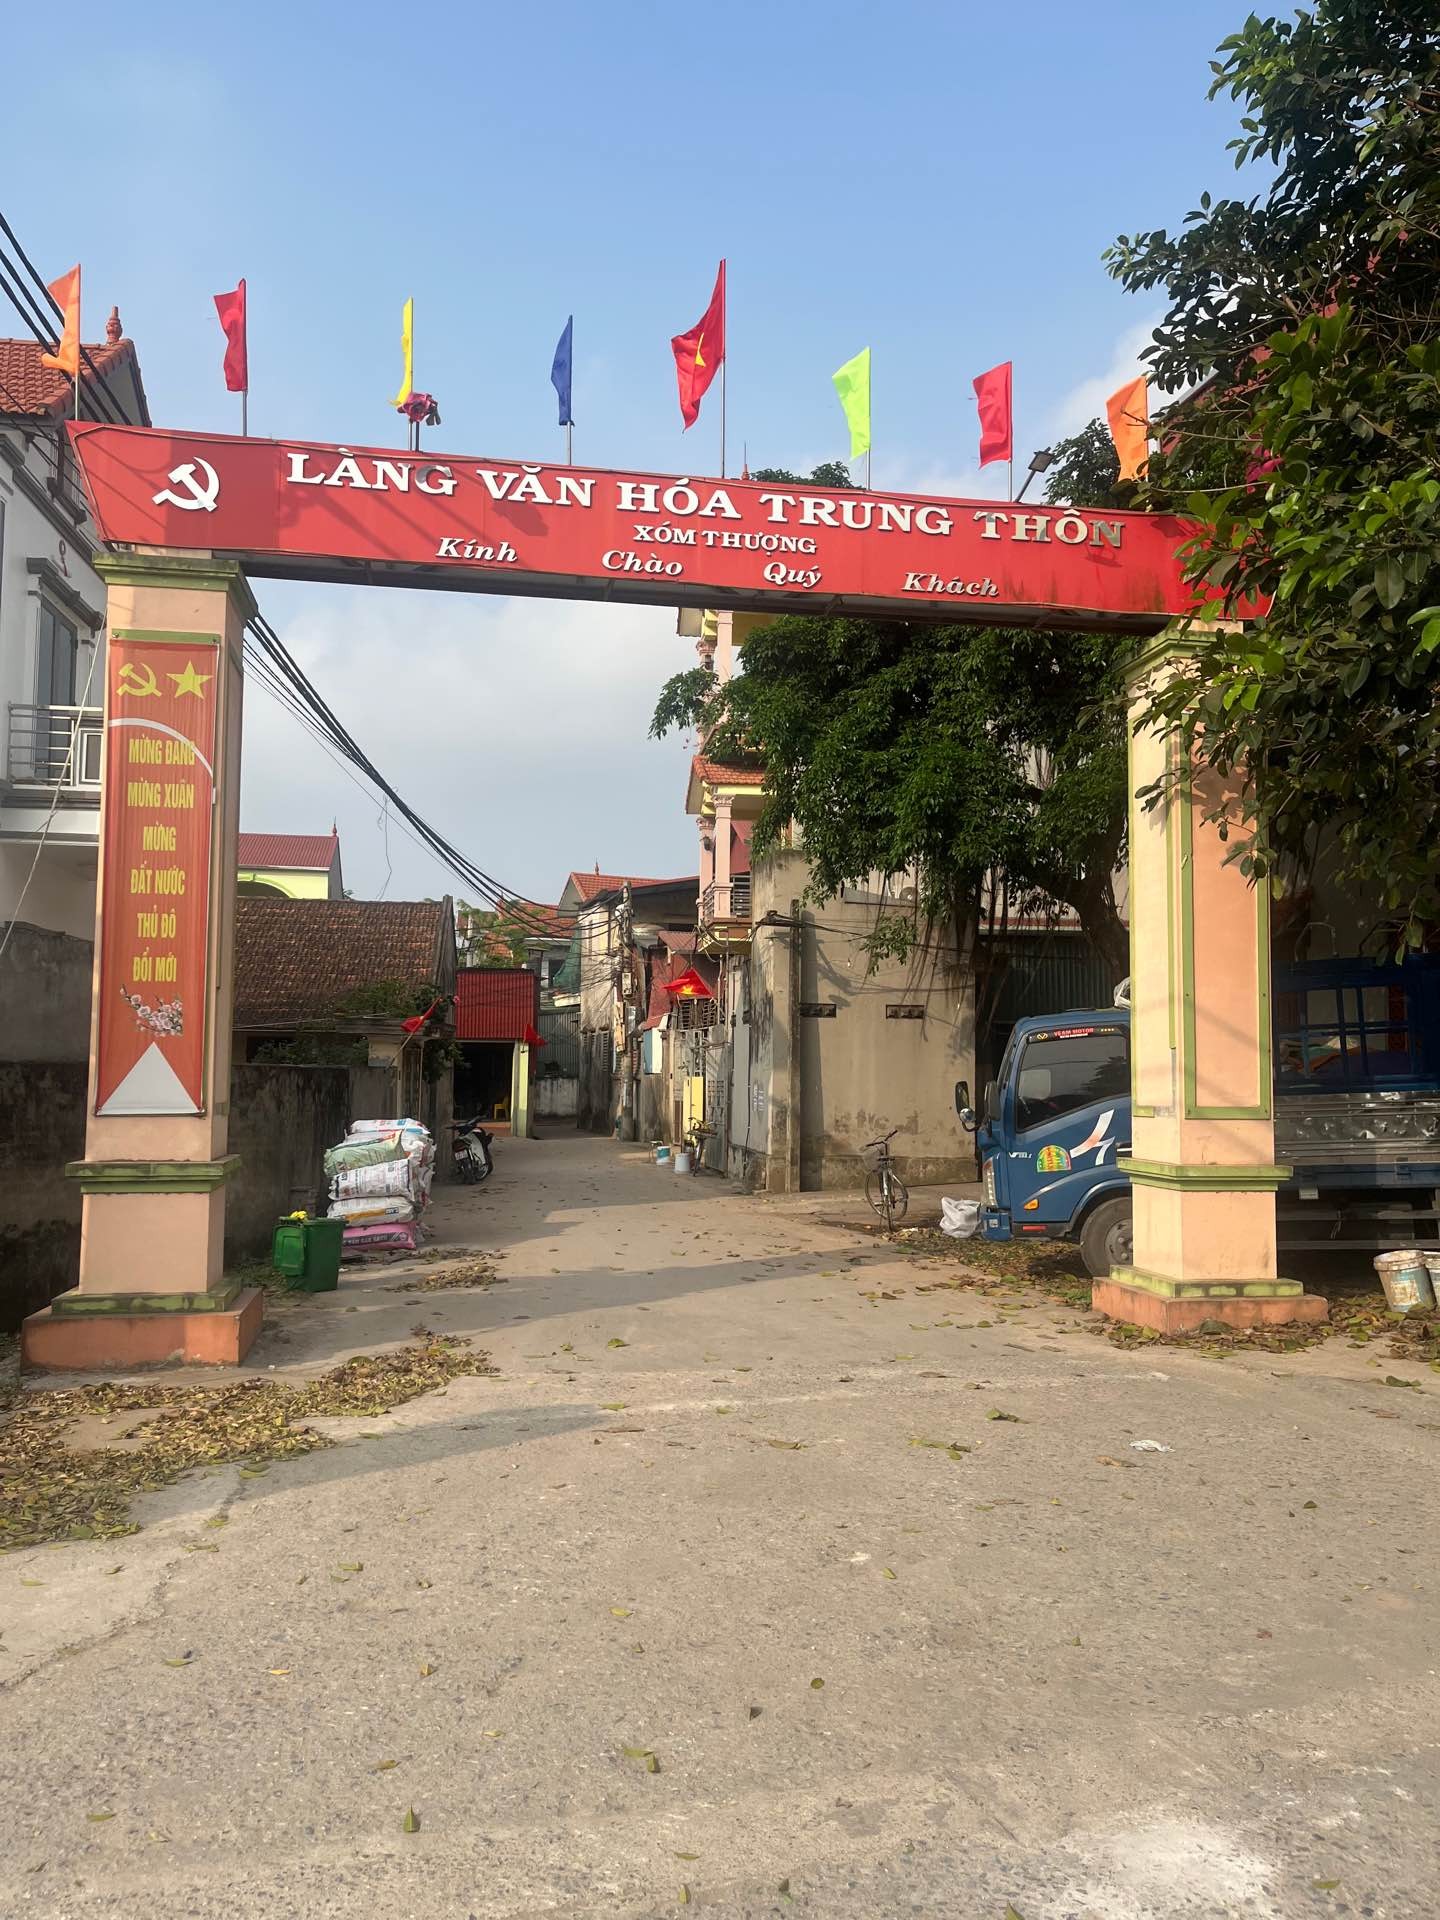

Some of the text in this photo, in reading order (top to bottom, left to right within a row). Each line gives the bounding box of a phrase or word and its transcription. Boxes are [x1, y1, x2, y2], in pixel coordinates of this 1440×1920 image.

[286, 447, 1125, 548] LÀNG VĂN HÓA TRUNG THÔN
[633, 520, 818, 556] XÓM THƯỢNG
[435, 536, 1000, 597] Kính Chào Quý Khách
[128, 733, 163, 765] MỪNG
[127, 777, 195, 809] MỪNG XUÂN
[142, 820, 177, 852] MỪNG
[130, 860, 186, 896] ĐẤT NƯỚC
[136, 904, 177, 939] THỦ ĐÔ
[132, 946, 178, 982] ĐỔI MỚI
